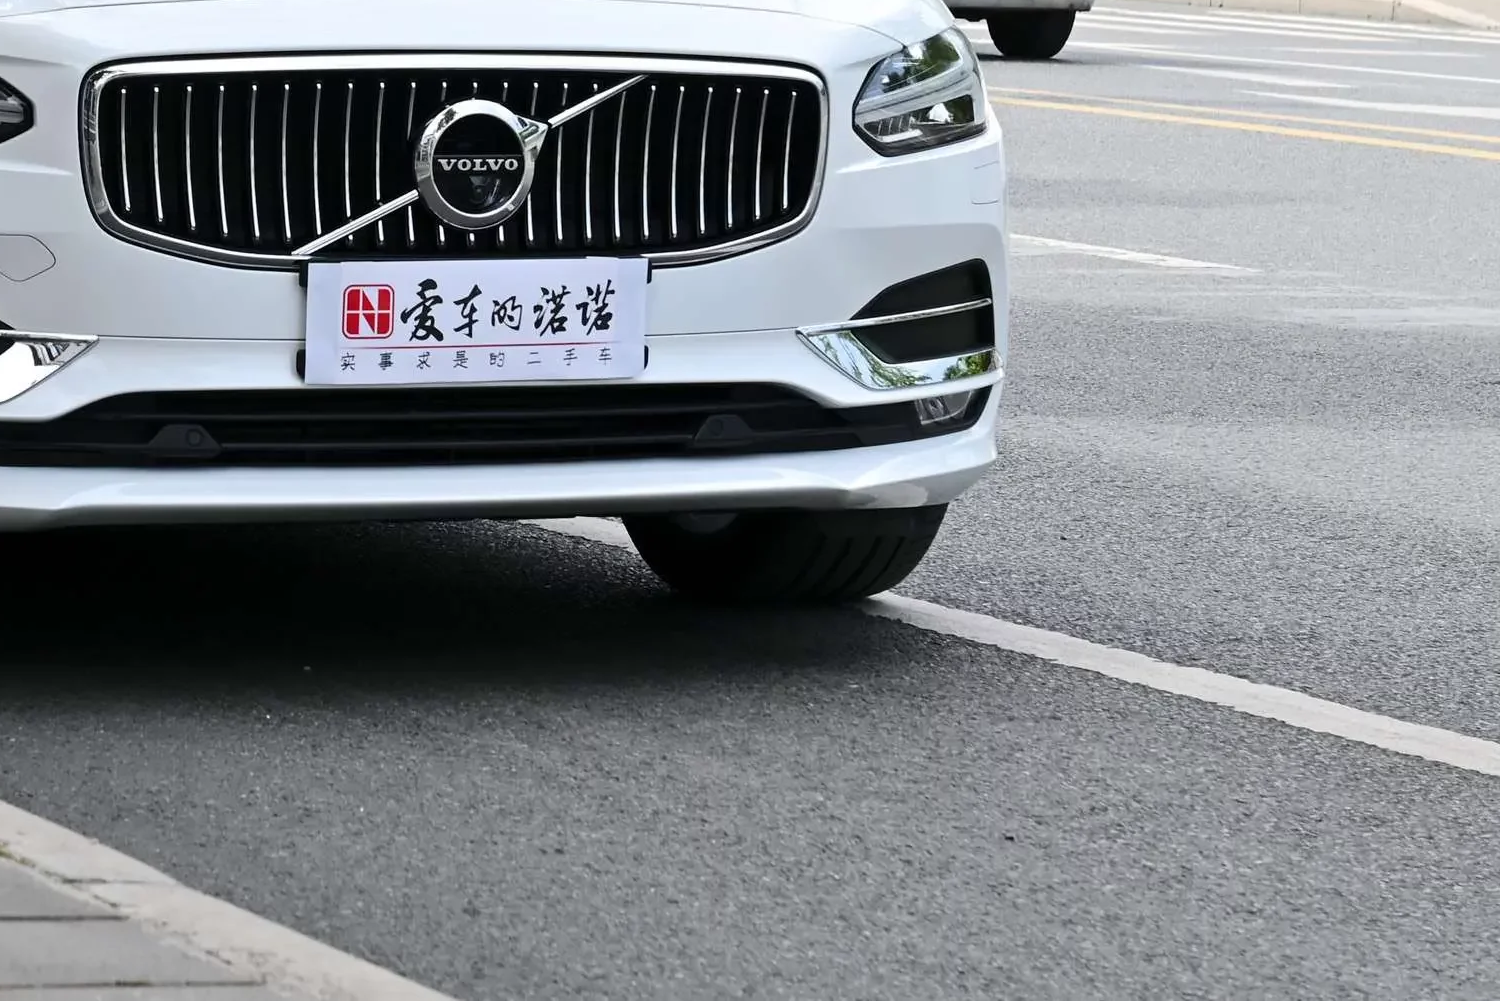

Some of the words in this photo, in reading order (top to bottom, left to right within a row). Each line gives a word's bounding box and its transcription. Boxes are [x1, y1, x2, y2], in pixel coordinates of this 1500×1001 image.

[437, 158, 519, 171] VOLVO
[340, 348, 612, 371] 实事求是的二手车
